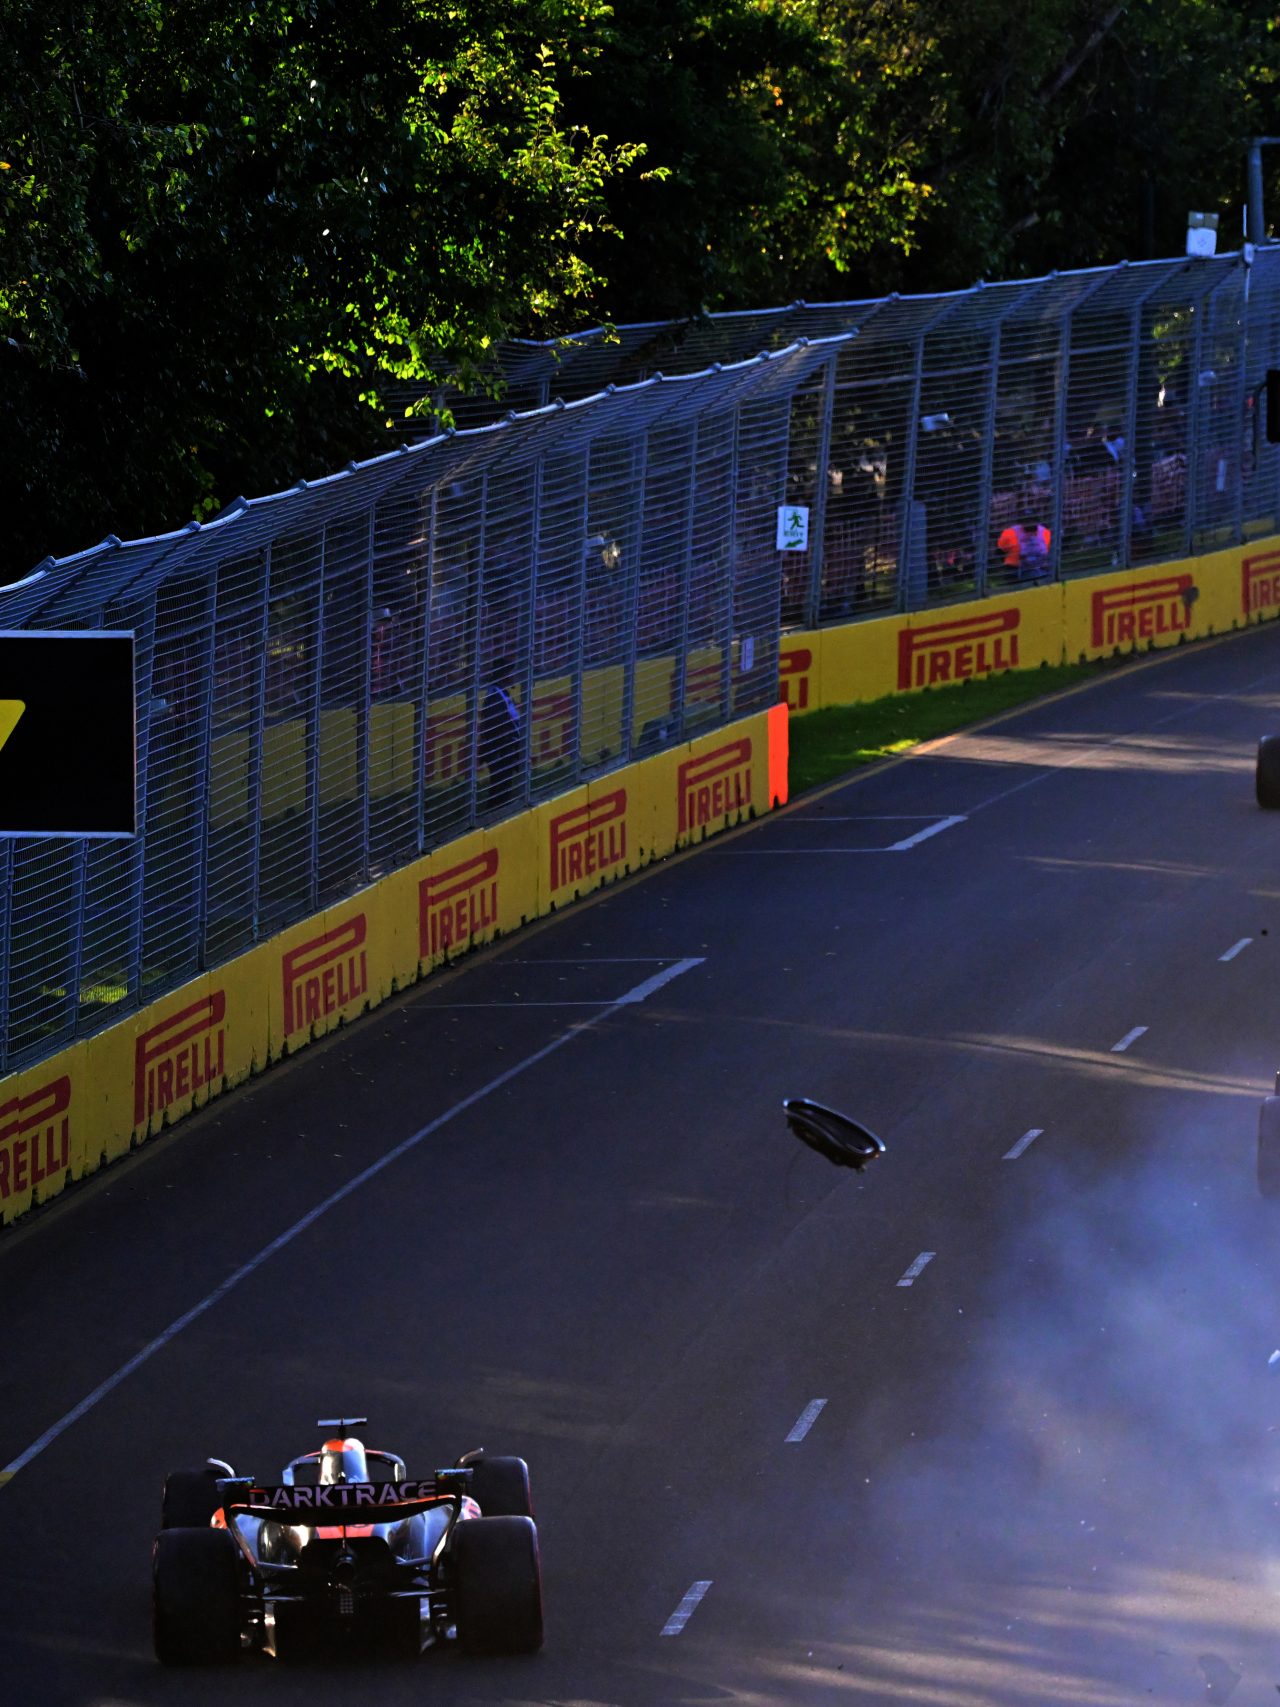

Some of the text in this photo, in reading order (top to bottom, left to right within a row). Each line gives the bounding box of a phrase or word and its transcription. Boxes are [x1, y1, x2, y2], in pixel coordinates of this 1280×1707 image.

[898, 608, 1020, 690] PIRELLI
[1091, 574, 1193, 648] PIRELLI
[678, 737, 752, 833] PIRELLI
[550, 788, 628, 893] PIRELLI
[418, 847, 499, 958] PIRELLI
[282, 912, 367, 1037] PIRELLI
[134, 989, 226, 1127] PIRELLI
[249, 1481, 437, 1508] DARKTRACE
